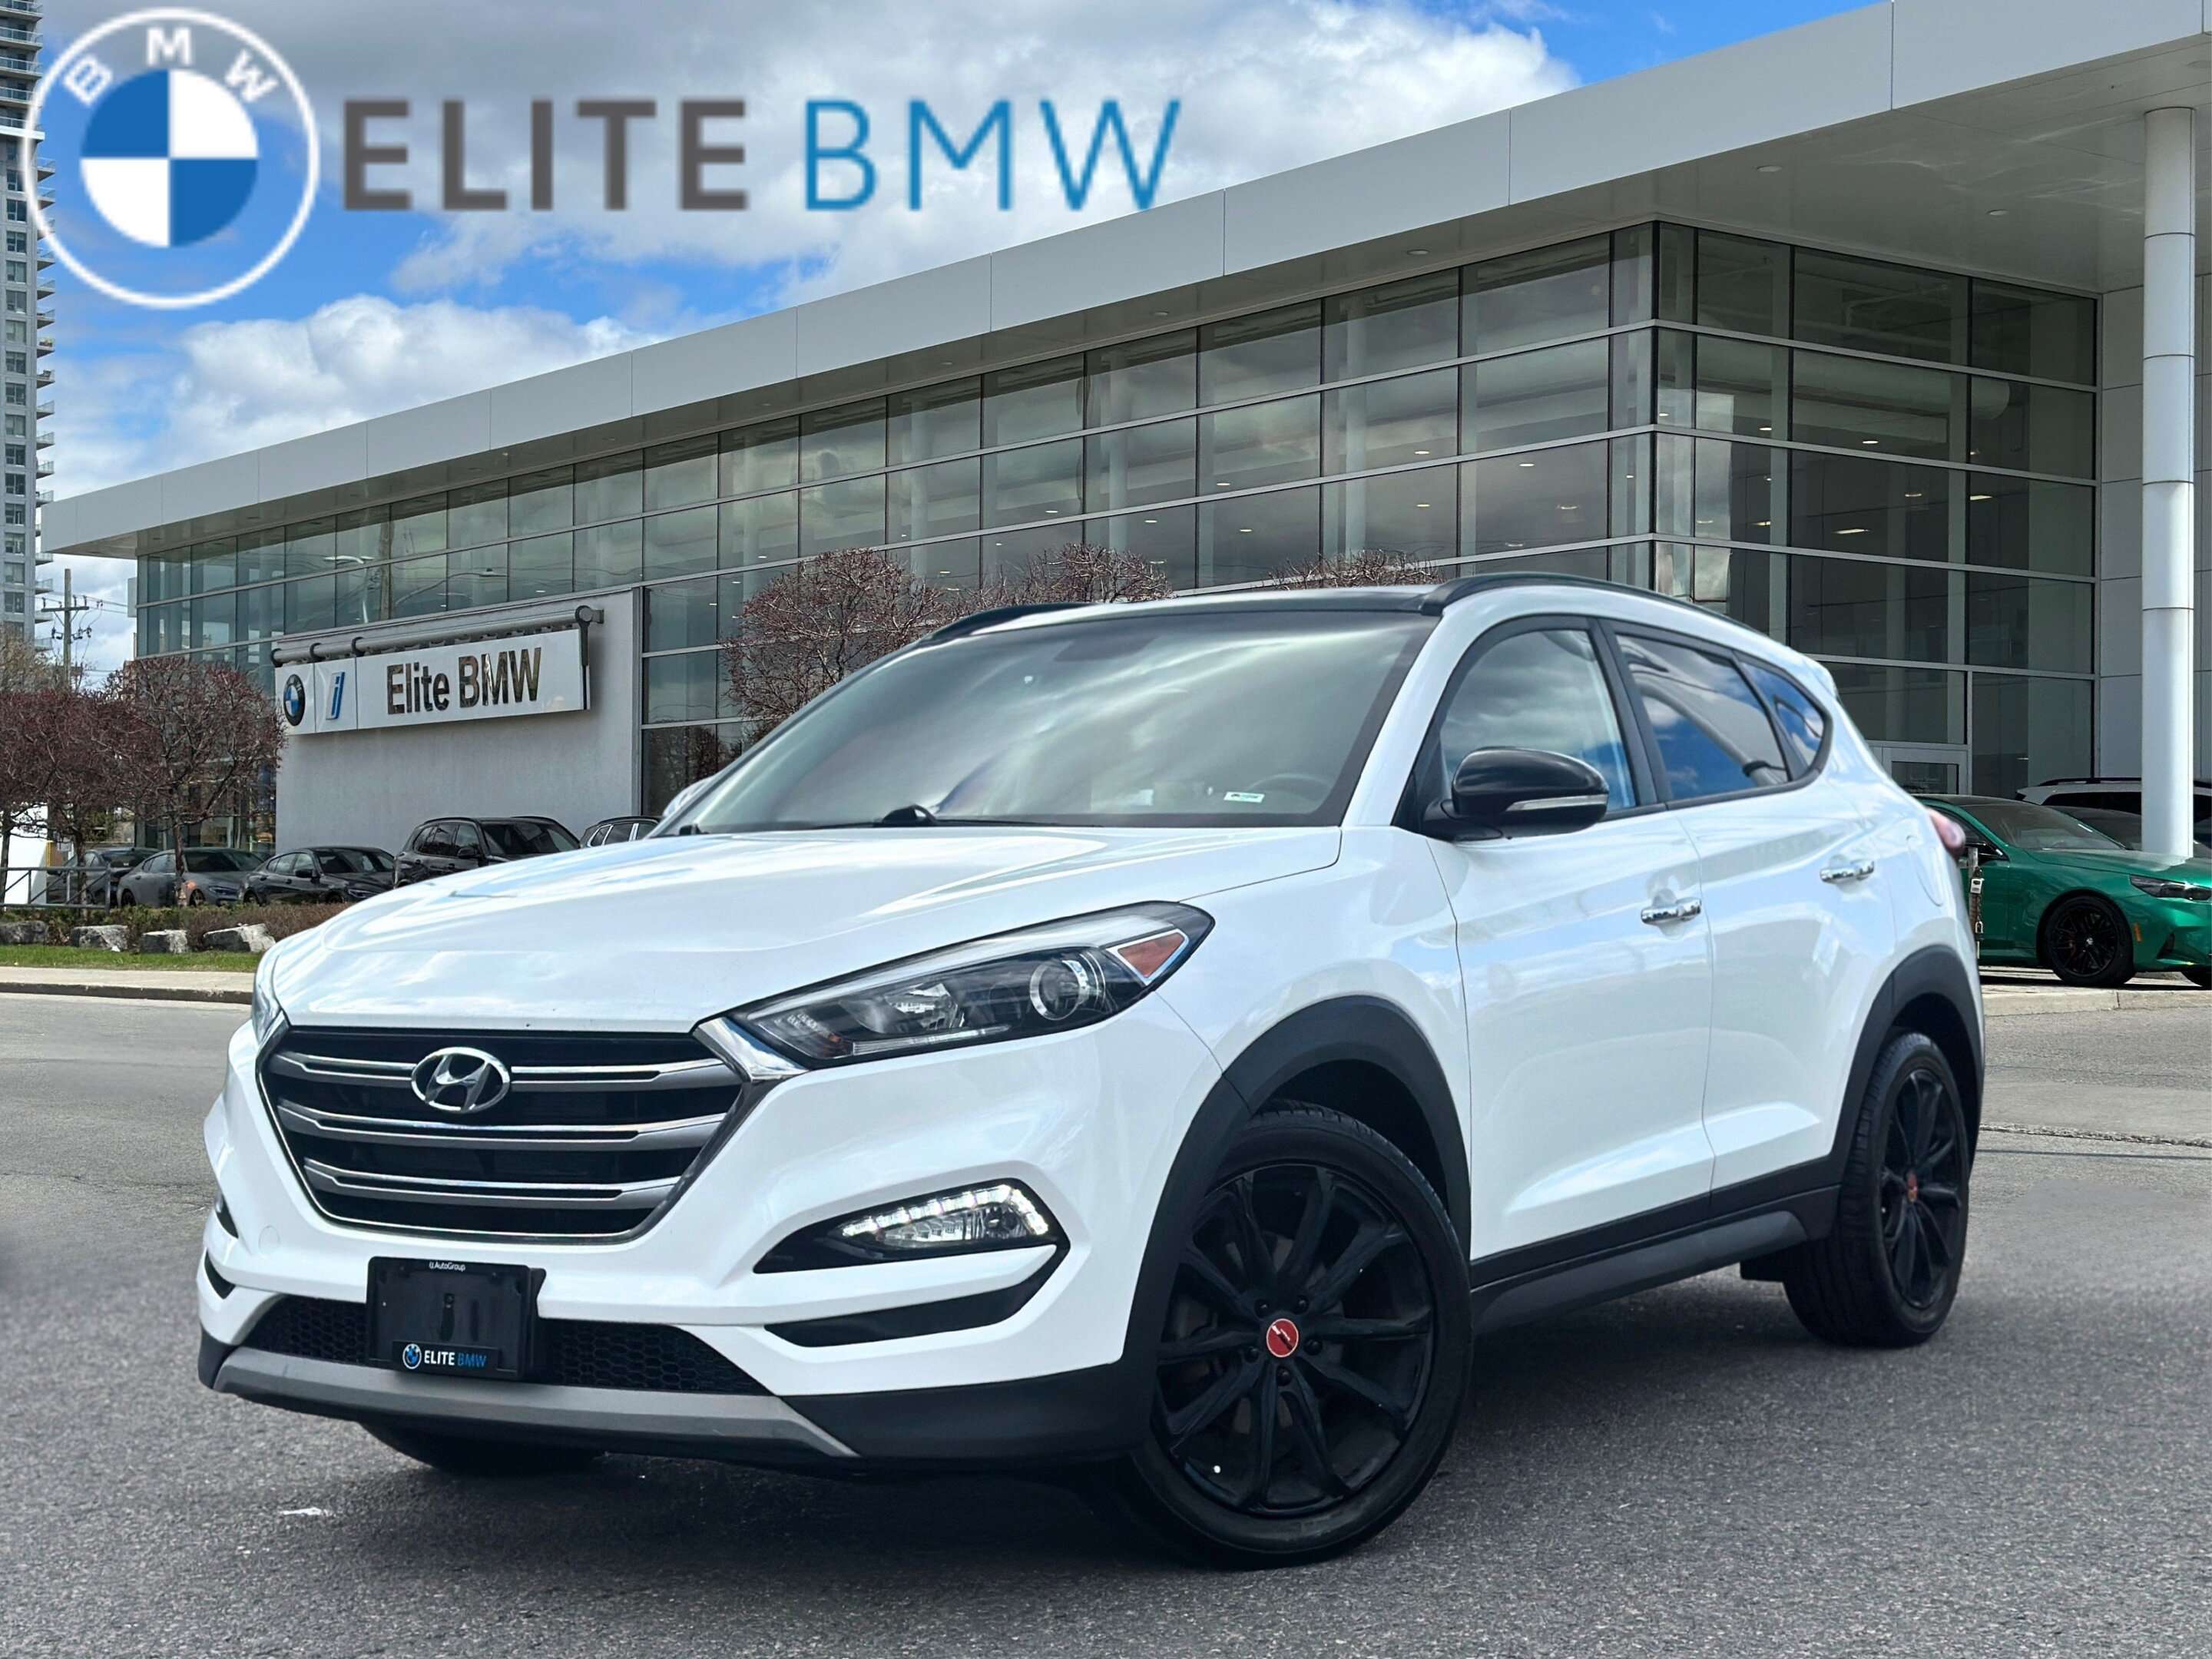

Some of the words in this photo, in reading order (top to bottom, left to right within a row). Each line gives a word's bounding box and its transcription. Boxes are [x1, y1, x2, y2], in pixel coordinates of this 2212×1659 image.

[386, 661, 450, 715] Elite
[458, 647, 542, 708] BMW
[424, 1349, 455, 1366] ELITE
[457, 1352, 487, 1367] BMW
